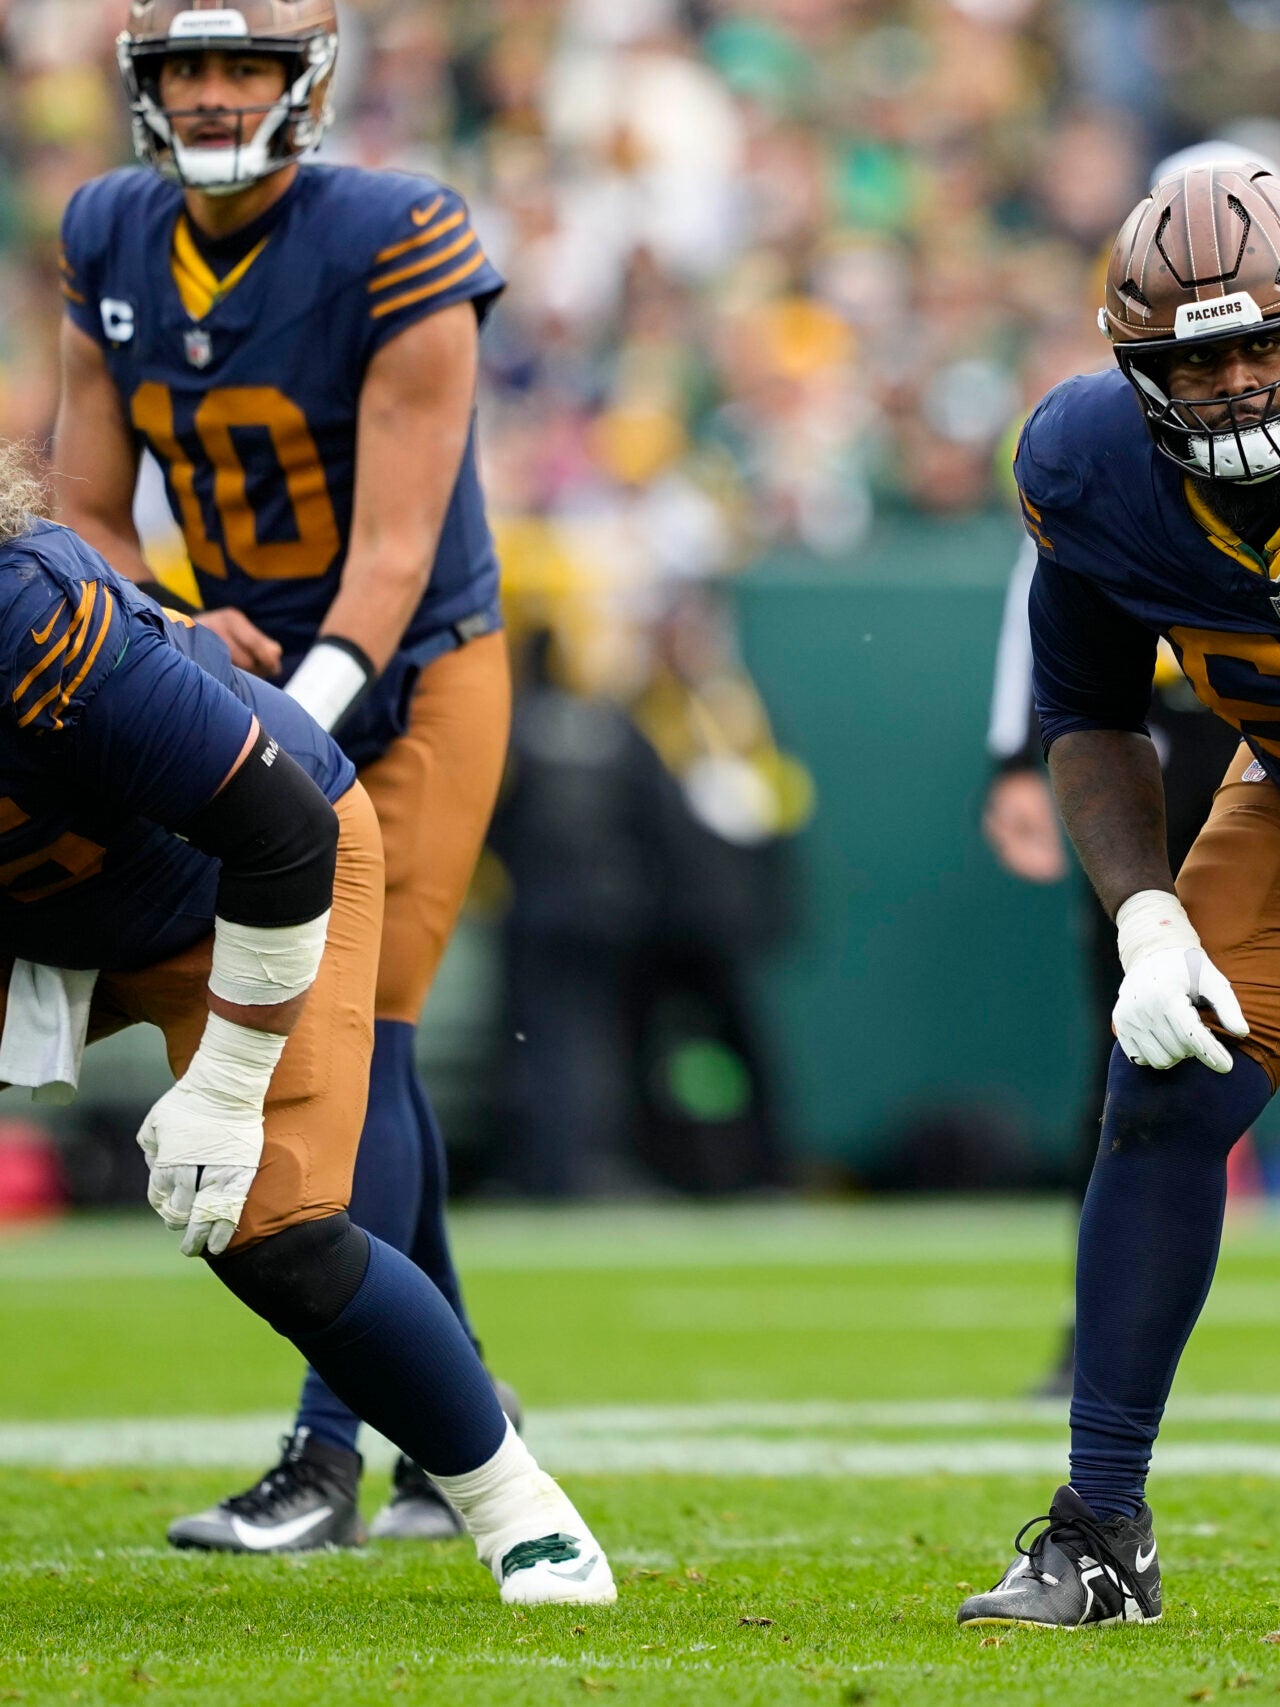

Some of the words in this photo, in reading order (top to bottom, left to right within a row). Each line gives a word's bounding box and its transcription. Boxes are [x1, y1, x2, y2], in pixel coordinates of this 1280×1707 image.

[100, 298, 134, 342] C
[1187, 301, 1242, 322] PACKERS
[131, 379, 341, 580] 10
